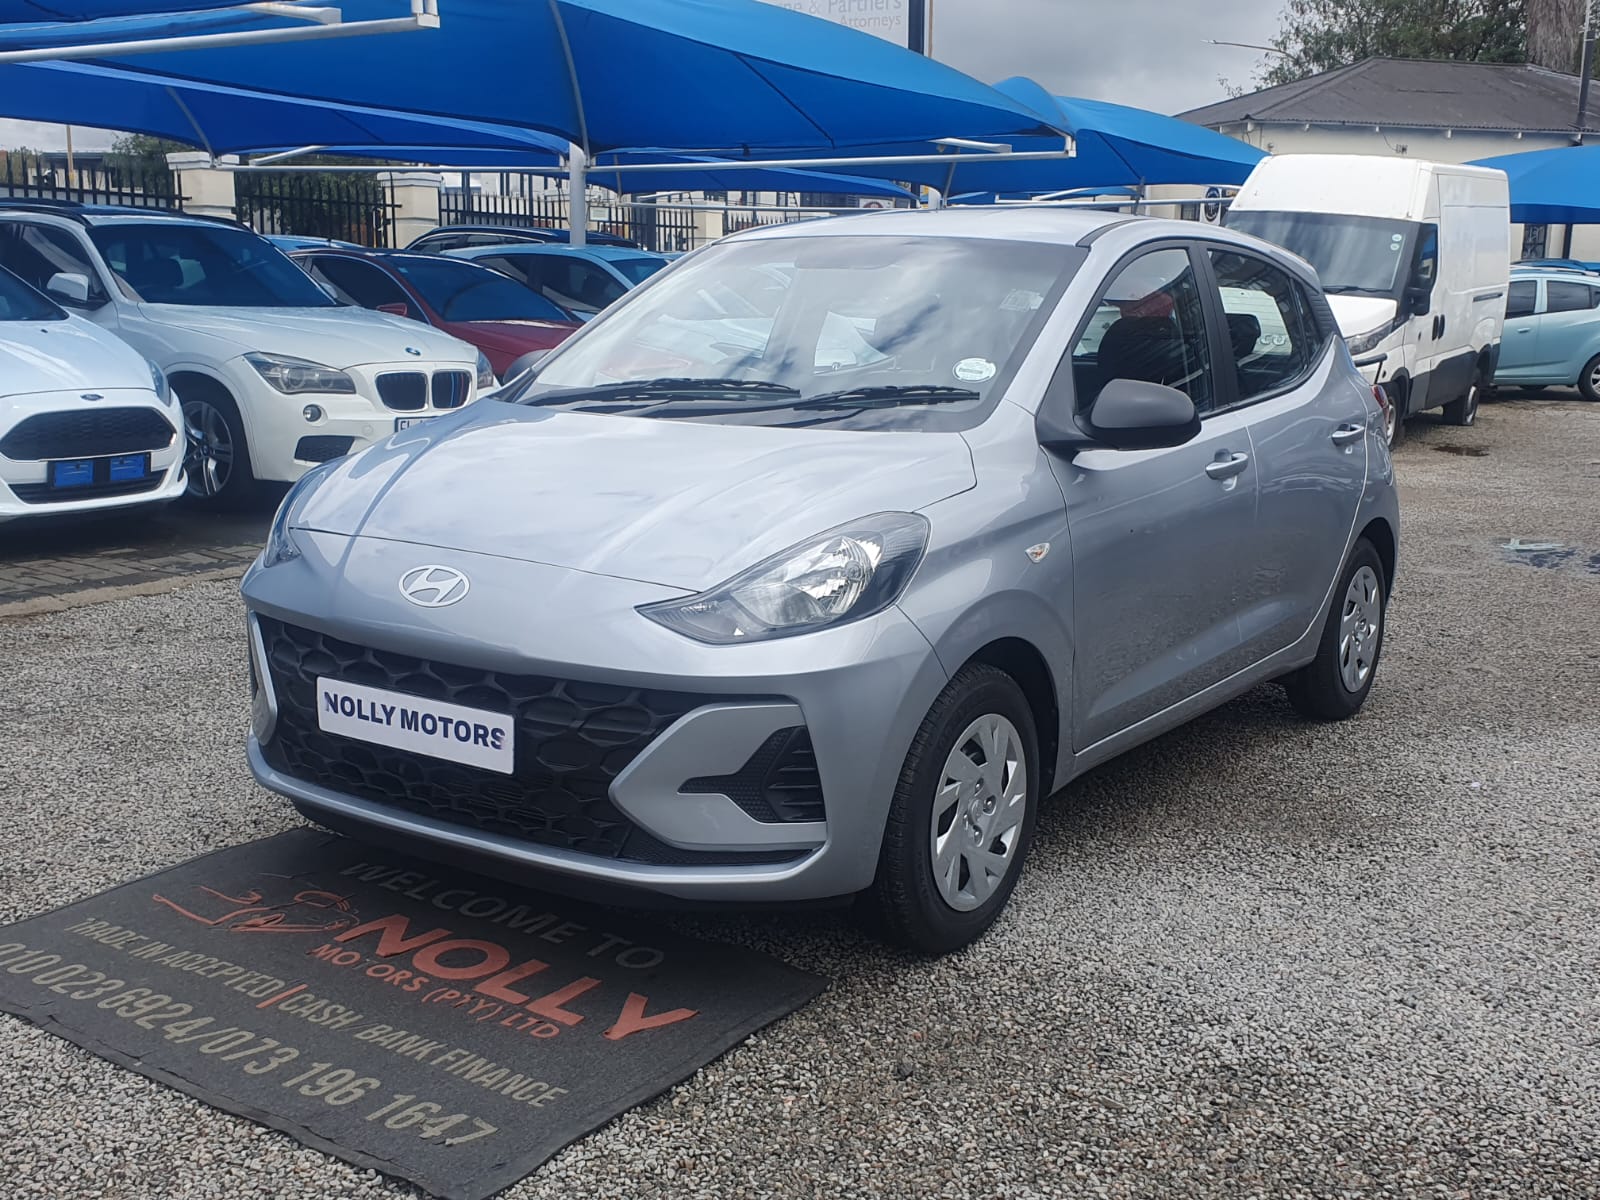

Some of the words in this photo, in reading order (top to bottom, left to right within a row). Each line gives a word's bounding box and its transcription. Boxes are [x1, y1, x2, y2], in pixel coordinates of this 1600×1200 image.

[840, 15, 902, 31] Attorneys
[323, 691, 397, 727] NOLLY
[400, 707, 507, 751] MOTORS
[339, 861, 589, 944] WELCOME
[586, 932, 665, 969] TO
[64, 917, 149, 950] TRADE
[128, 941, 175, 960] IN
[430, 1047, 569, 1108] FINANCE
[310, 943, 430, 992] MOTORS
[421, 986, 504, 1022] (PTY)
[500, 1012, 560, 1038] LTD
[333, 914, 701, 1041] NOLLY
[281, 1060, 382, 1106] 196
[365, 1093, 500, 1147] 1647
